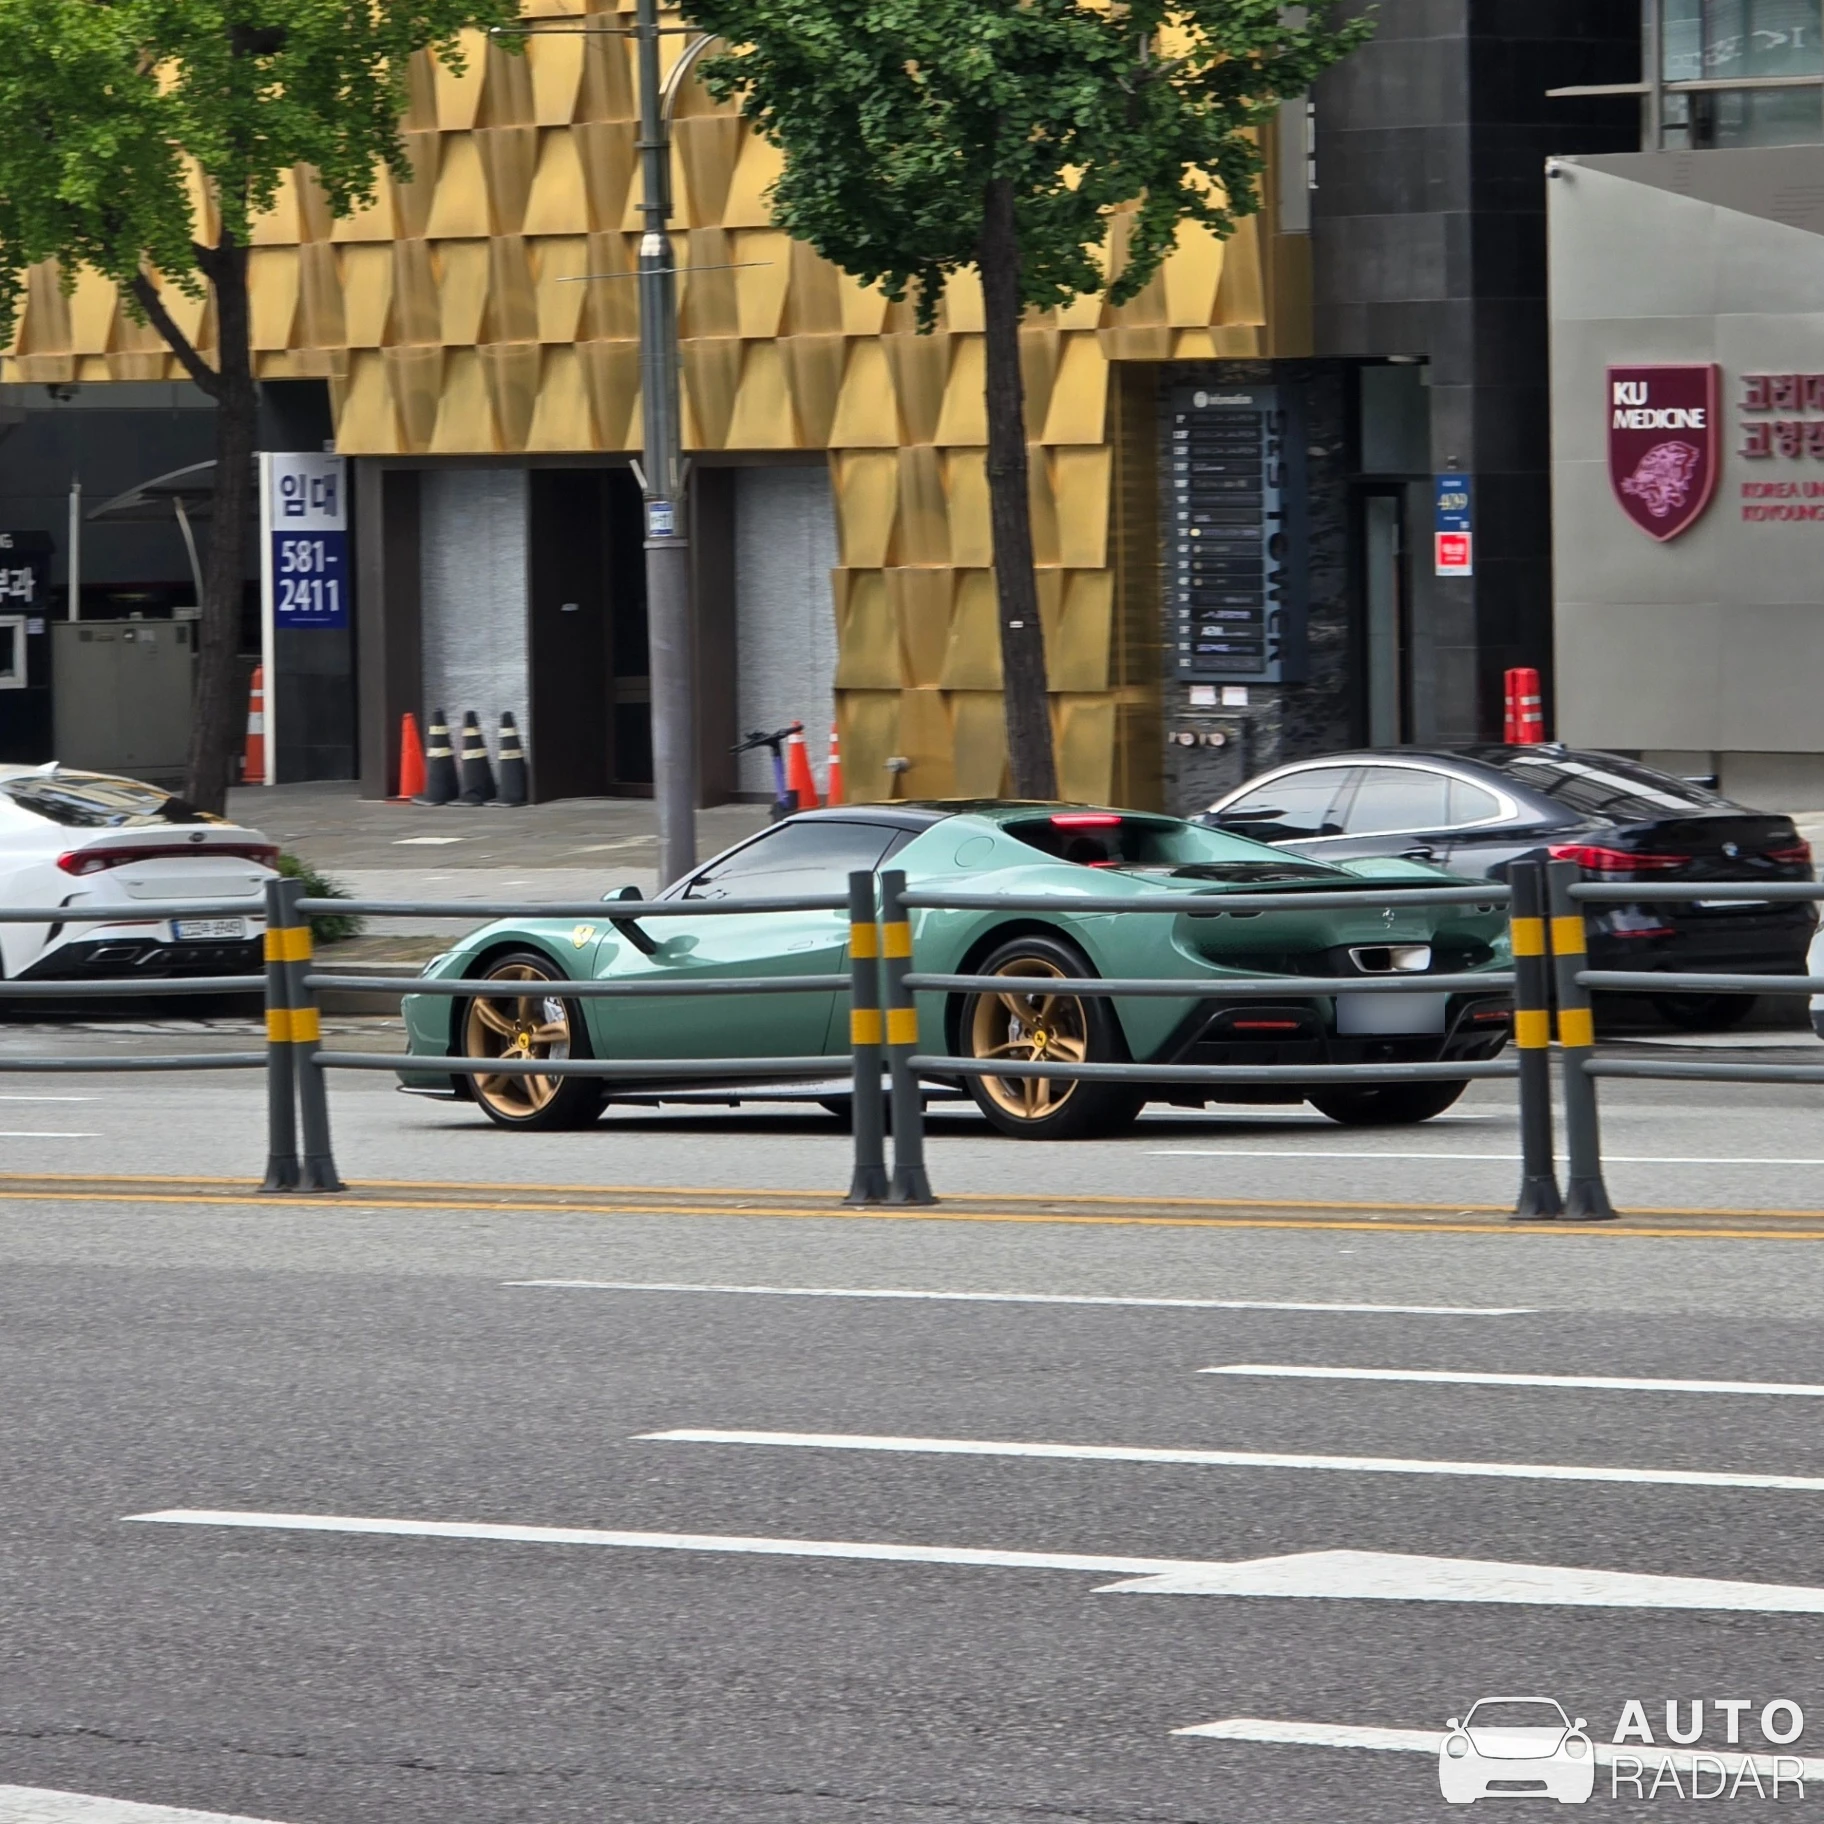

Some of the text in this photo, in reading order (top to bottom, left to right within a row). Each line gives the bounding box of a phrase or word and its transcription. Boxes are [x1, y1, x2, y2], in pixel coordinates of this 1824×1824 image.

[1613, 381, 1648, 405] KU
[1612, 408, 1707, 429] MEDICINE
[280, 474, 338, 517] 임대
[1741, 482, 1800, 498] KOREA
[280, 540, 338, 573] 581-
[279, 578, 340, 612] 2411
